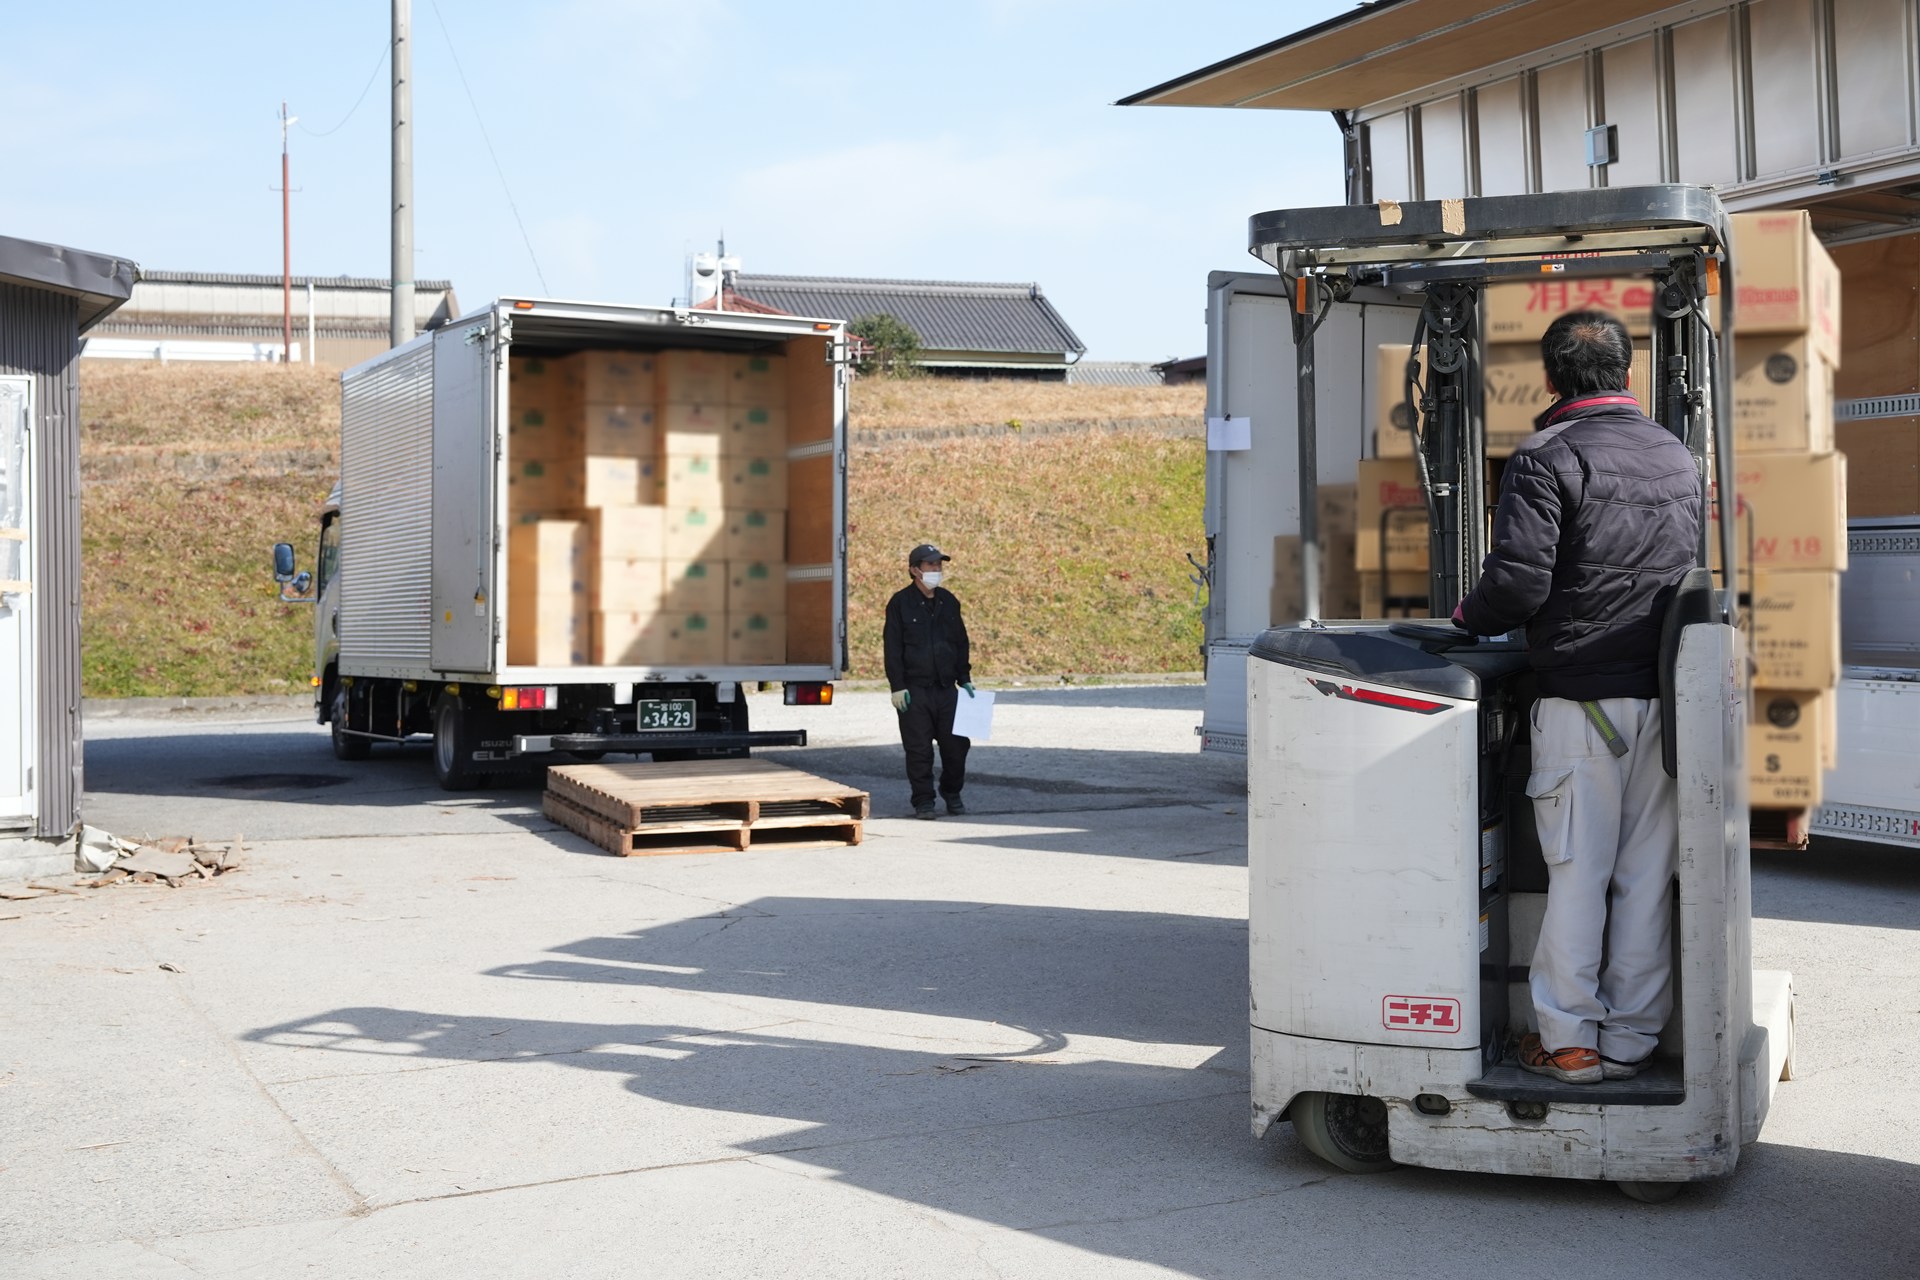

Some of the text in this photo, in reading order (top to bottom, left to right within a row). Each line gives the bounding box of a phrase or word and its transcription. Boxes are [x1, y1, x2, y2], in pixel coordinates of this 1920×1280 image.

[1790, 536, 1821, 556] 18
[651, 711, 691, 727] 34-29
[480, 740, 513, 748] ISUZU
[1766, 753, 1781, 773] S
[1389, 1002, 1454, 1027] ニチユ
